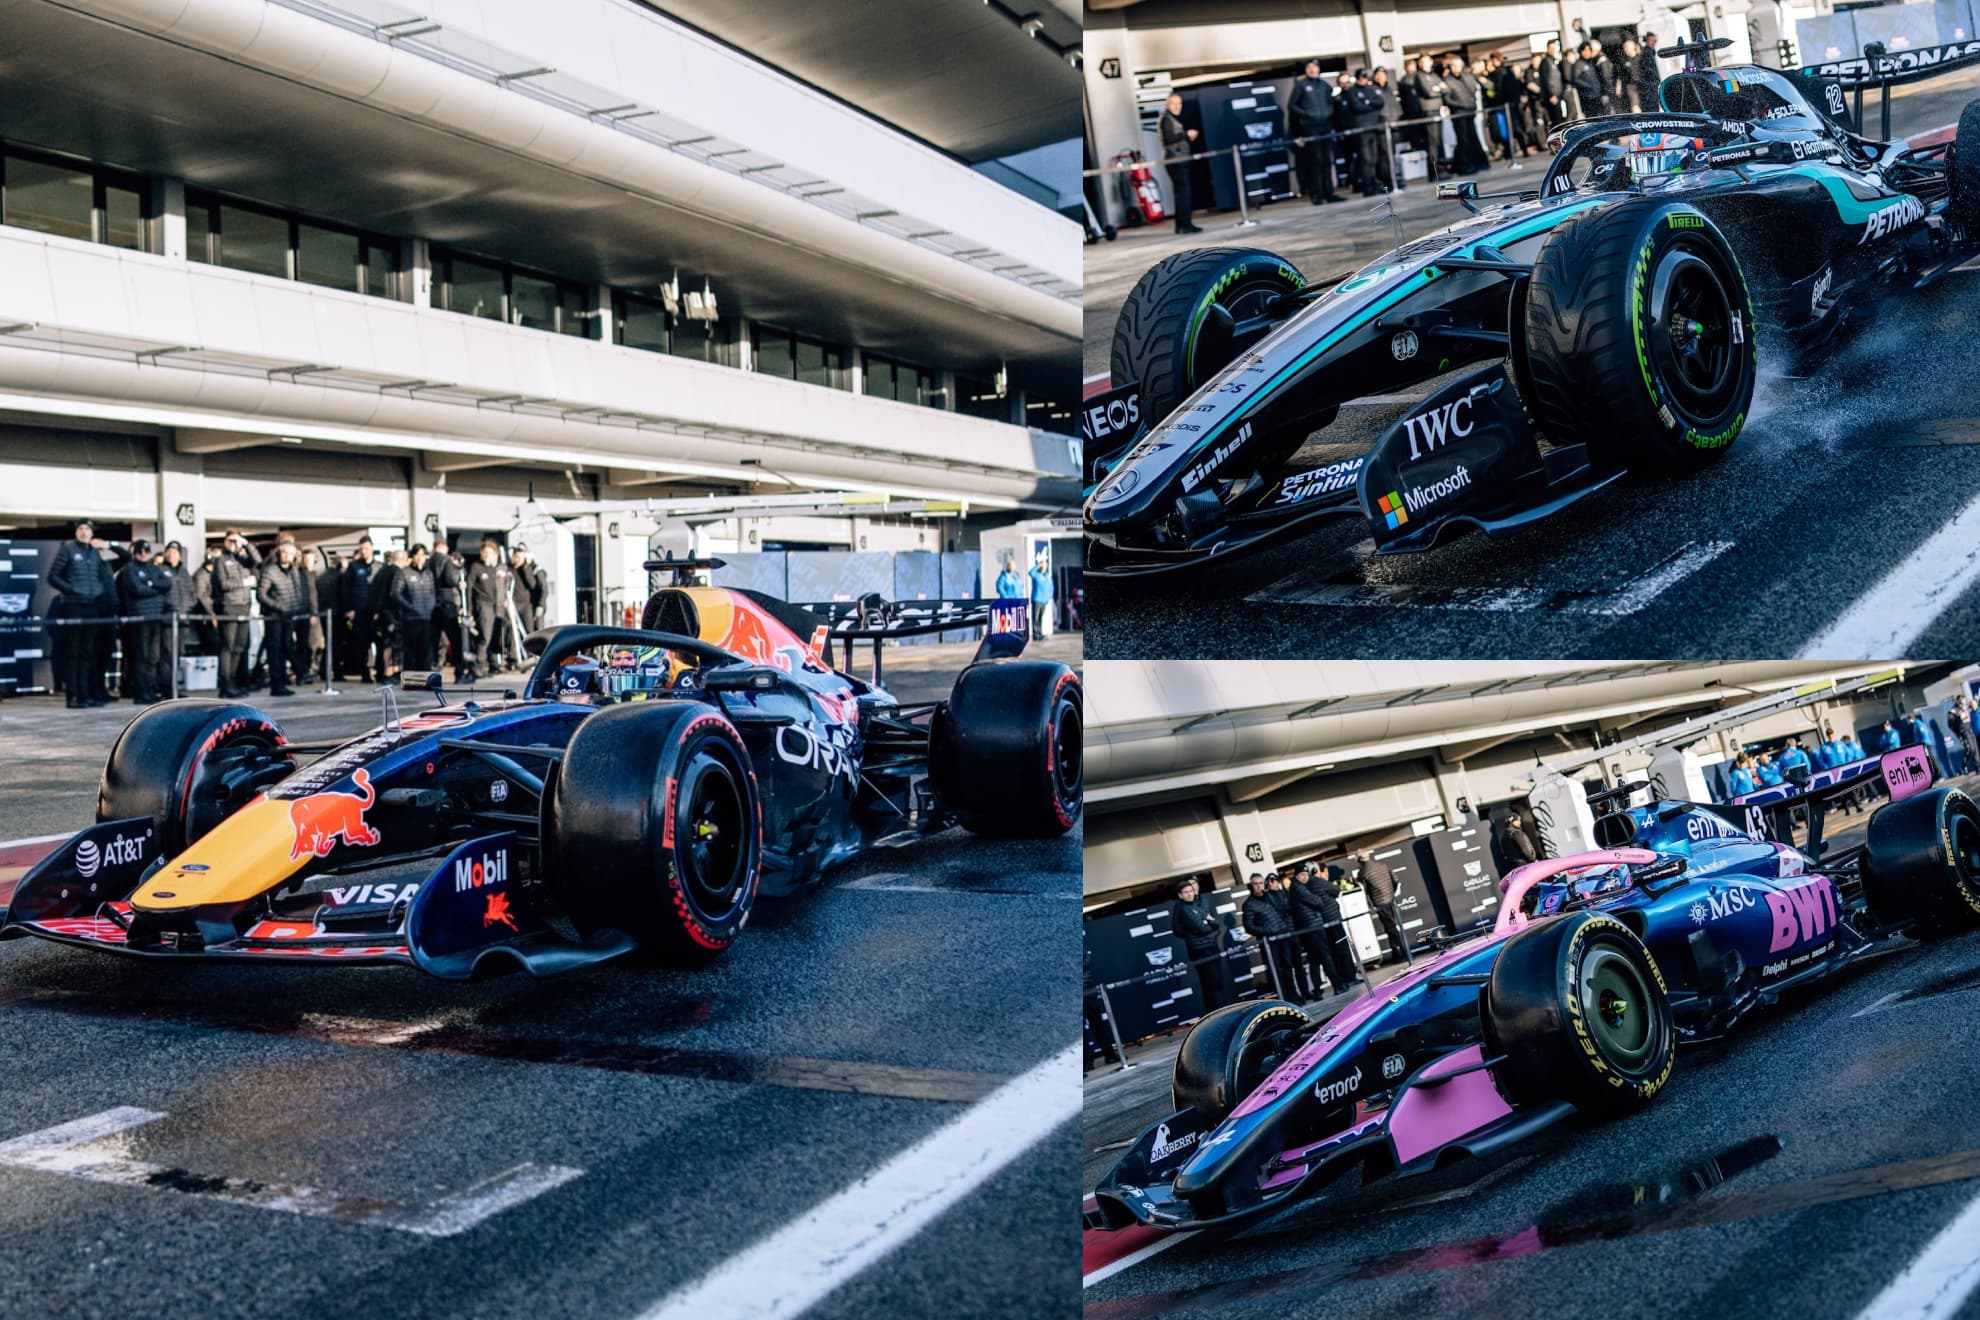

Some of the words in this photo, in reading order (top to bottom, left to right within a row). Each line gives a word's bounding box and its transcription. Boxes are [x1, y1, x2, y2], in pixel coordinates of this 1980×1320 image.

[1101, 60, 1119, 77] 47
[1826, 84, 1845, 115] 12
[1635, 120, 1696, 130] CROWDSTRIKE
[1722, 121, 1740, 133] AMD
[1712, 149, 1750, 163] PETRONAS
[1666, 212, 1704, 229] PIRELLI
[1857, 194, 1926, 246] PETRONA
[1392, 331, 1419, 361] FIA
[1083, 393, 1139, 441] NEOS
[1403, 395, 1475, 462] IWC
[1696, 412, 1744, 449] Cinturato
[1180, 421, 1253, 494] Einhell
[1283, 457, 1364, 487] PETRONA
[1403, 464, 1473, 513] Microsoft
[991, 608, 1018, 635] Mobil
[604, 665, 643, 677] ORACLE
[775, 723, 856, 782] ORA
[1889, 761, 1908, 787] eni
[490, 780, 509, 803] FIA
[1686, 815, 1714, 841] eni
[1744, 805, 1768, 842] 43
[103, 836, 146, 867] AT&T
[1248, 842, 1262, 861] 46
[455, 849, 507, 893] Mobil
[323, 882, 421, 905] VISA
[1707, 884, 1756, 922] MSC
[1763, 872, 1838, 955] BWT
[1762, 958, 1789, 977] Delphi
[1567, 993, 1609, 1074] ZERO
[1382, 1054, 1405, 1078] FIA
[1608, 1076, 1624, 1088] P
[1150, 1131, 1198, 1162] OAKBERRY
